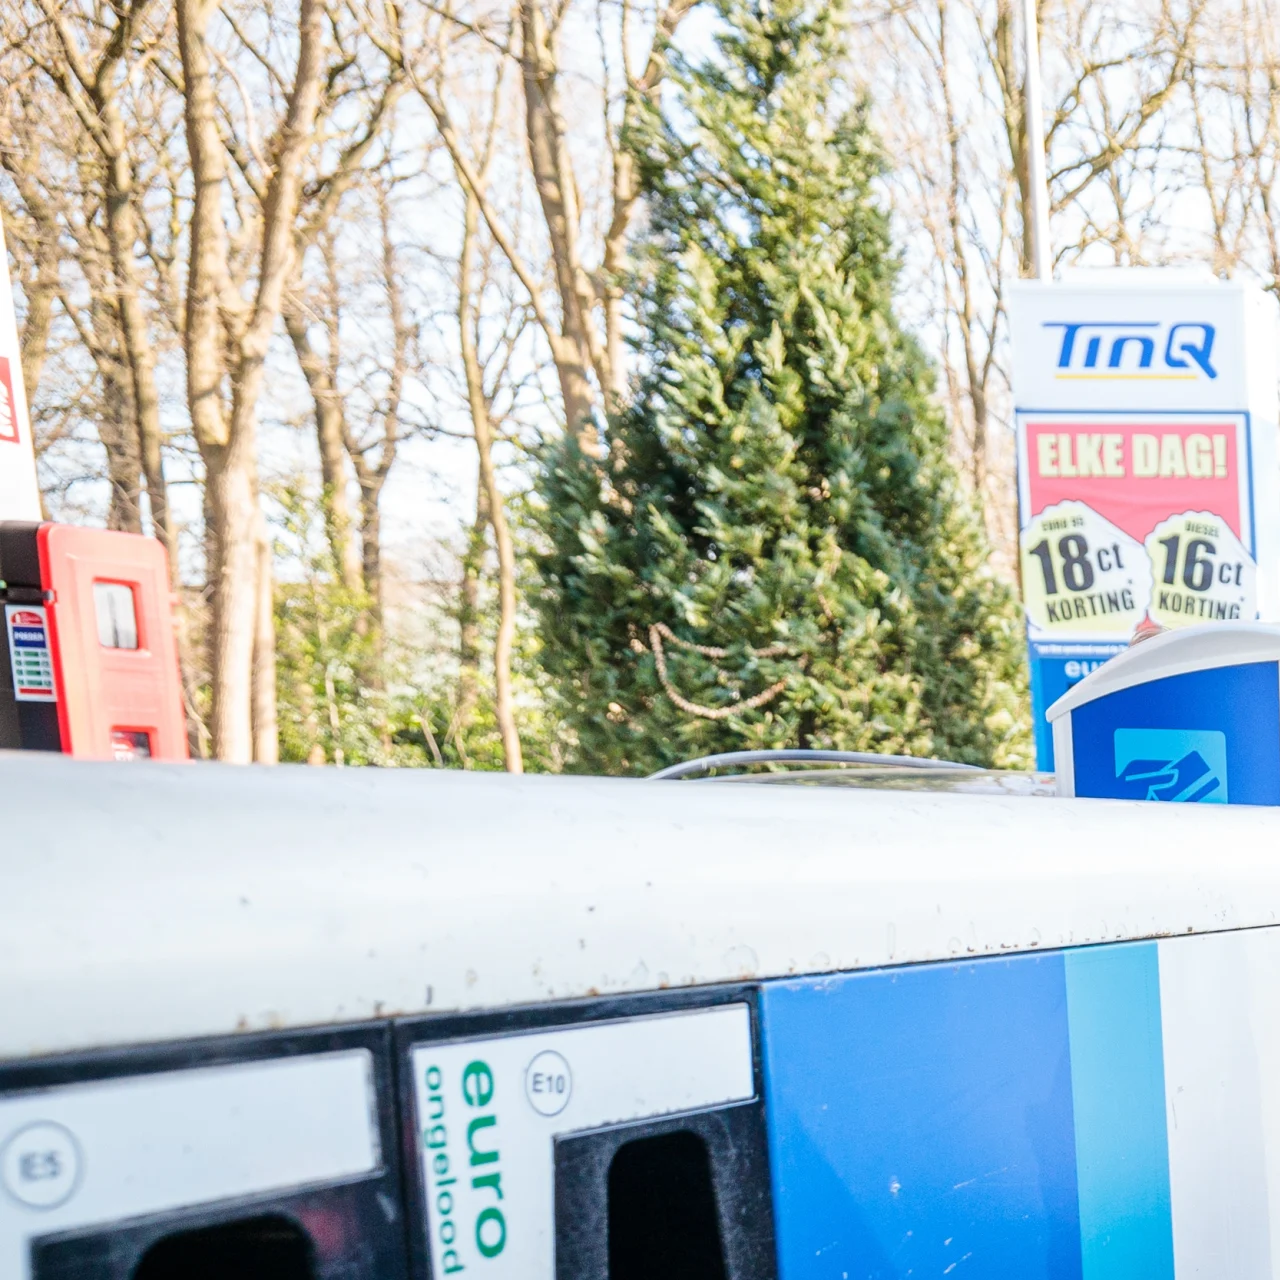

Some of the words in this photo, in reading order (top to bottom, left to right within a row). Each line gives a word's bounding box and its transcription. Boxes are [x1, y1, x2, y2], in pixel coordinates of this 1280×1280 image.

[1042, 322, 1218, 379] TinQ
[1037, 433, 1125, 478] ELKE
[1132, 433, 1228, 478] DAG!
[1184, 520, 1219, 538] DIESEL
[1029, 534, 1094, 595] 18
[1097, 542, 1124, 572] ct
[1159, 535, 1217, 592] 16
[1219, 562, 1243, 586] ct
[532, 1072, 565, 1096] E10
[424, 1066, 466, 1276] ongelood
[462, 1059, 509, 1259] euro
